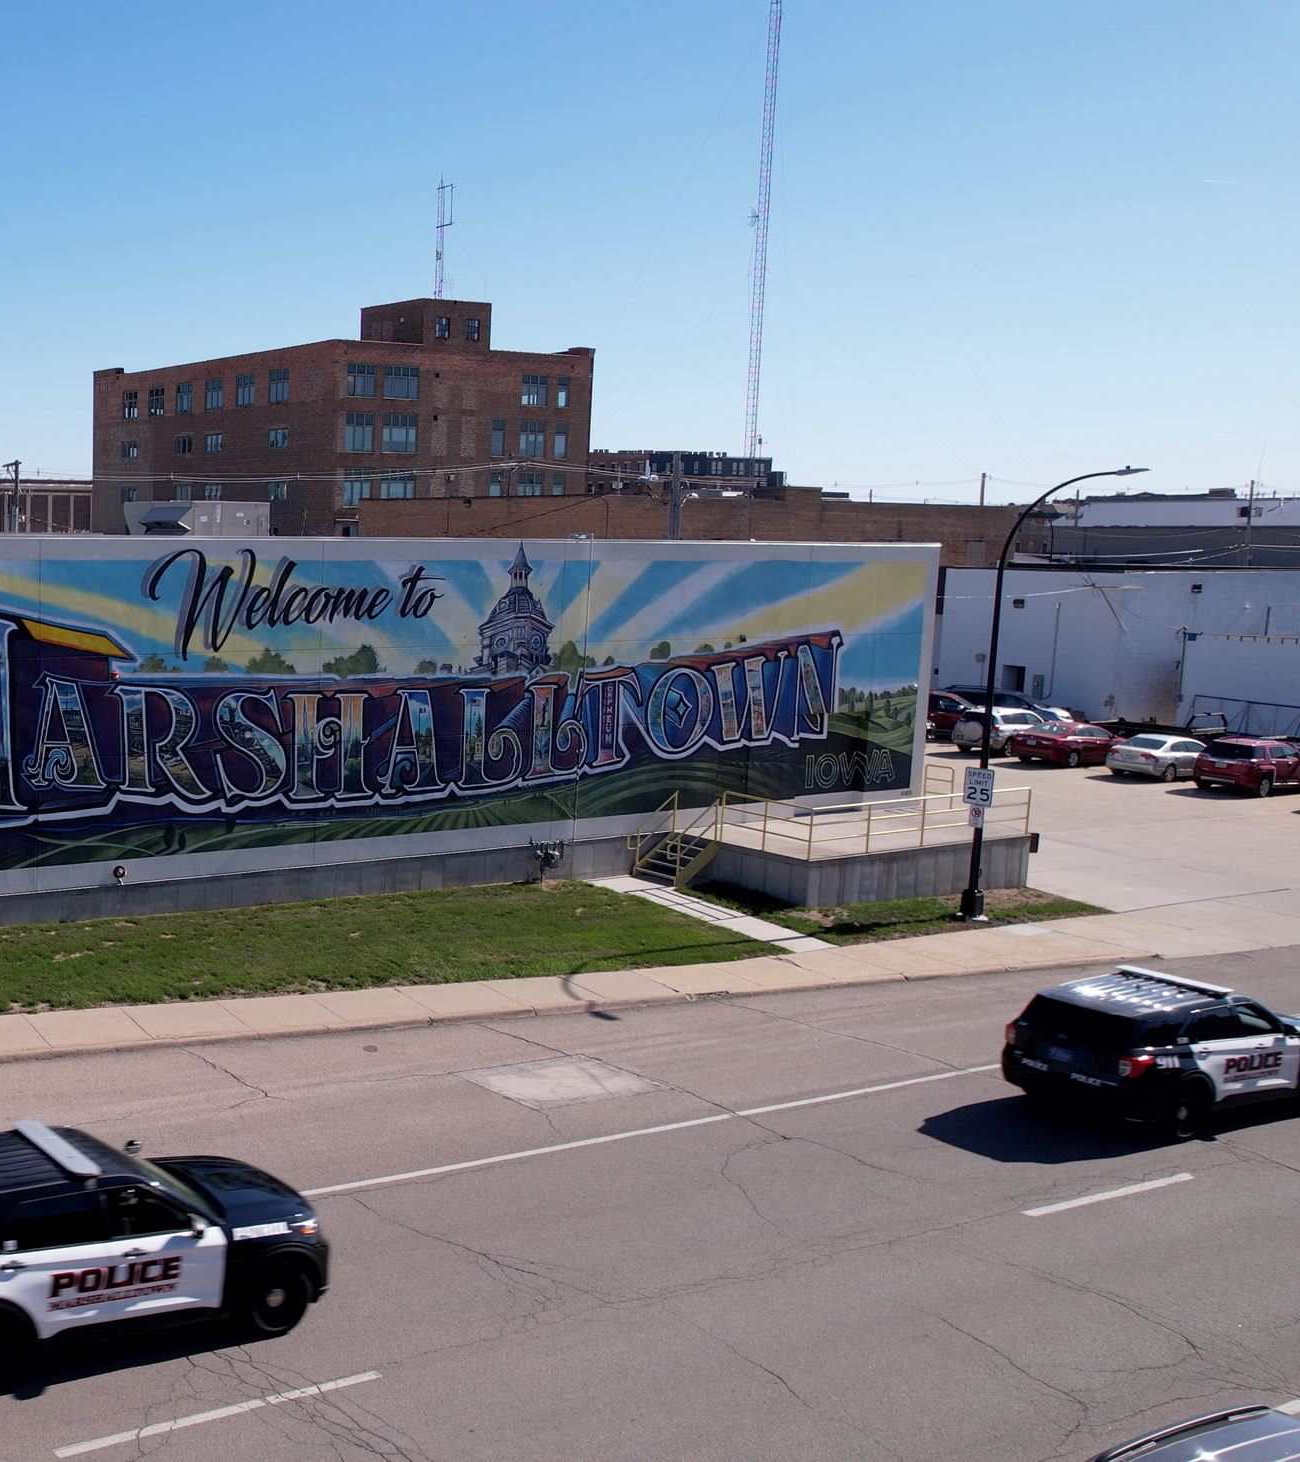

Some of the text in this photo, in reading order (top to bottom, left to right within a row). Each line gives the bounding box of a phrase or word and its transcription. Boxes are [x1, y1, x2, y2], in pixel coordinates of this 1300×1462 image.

[146, 548, 446, 662] Welcome to
[605, 685, 615, 745] ORPHEUM
[805, 749, 895, 789] IOWA
[968, 771, 992, 780] SPEED
[969, 779, 989, 787] LIMIT
[966, 786, 990, 802] 25
[1156, 1055, 1180, 1069] 911
[1224, 1051, 1283, 1075] POLICE
[1070, 1072, 1101, 1087] POLICE
[47, 1255, 182, 1299] POLICE
